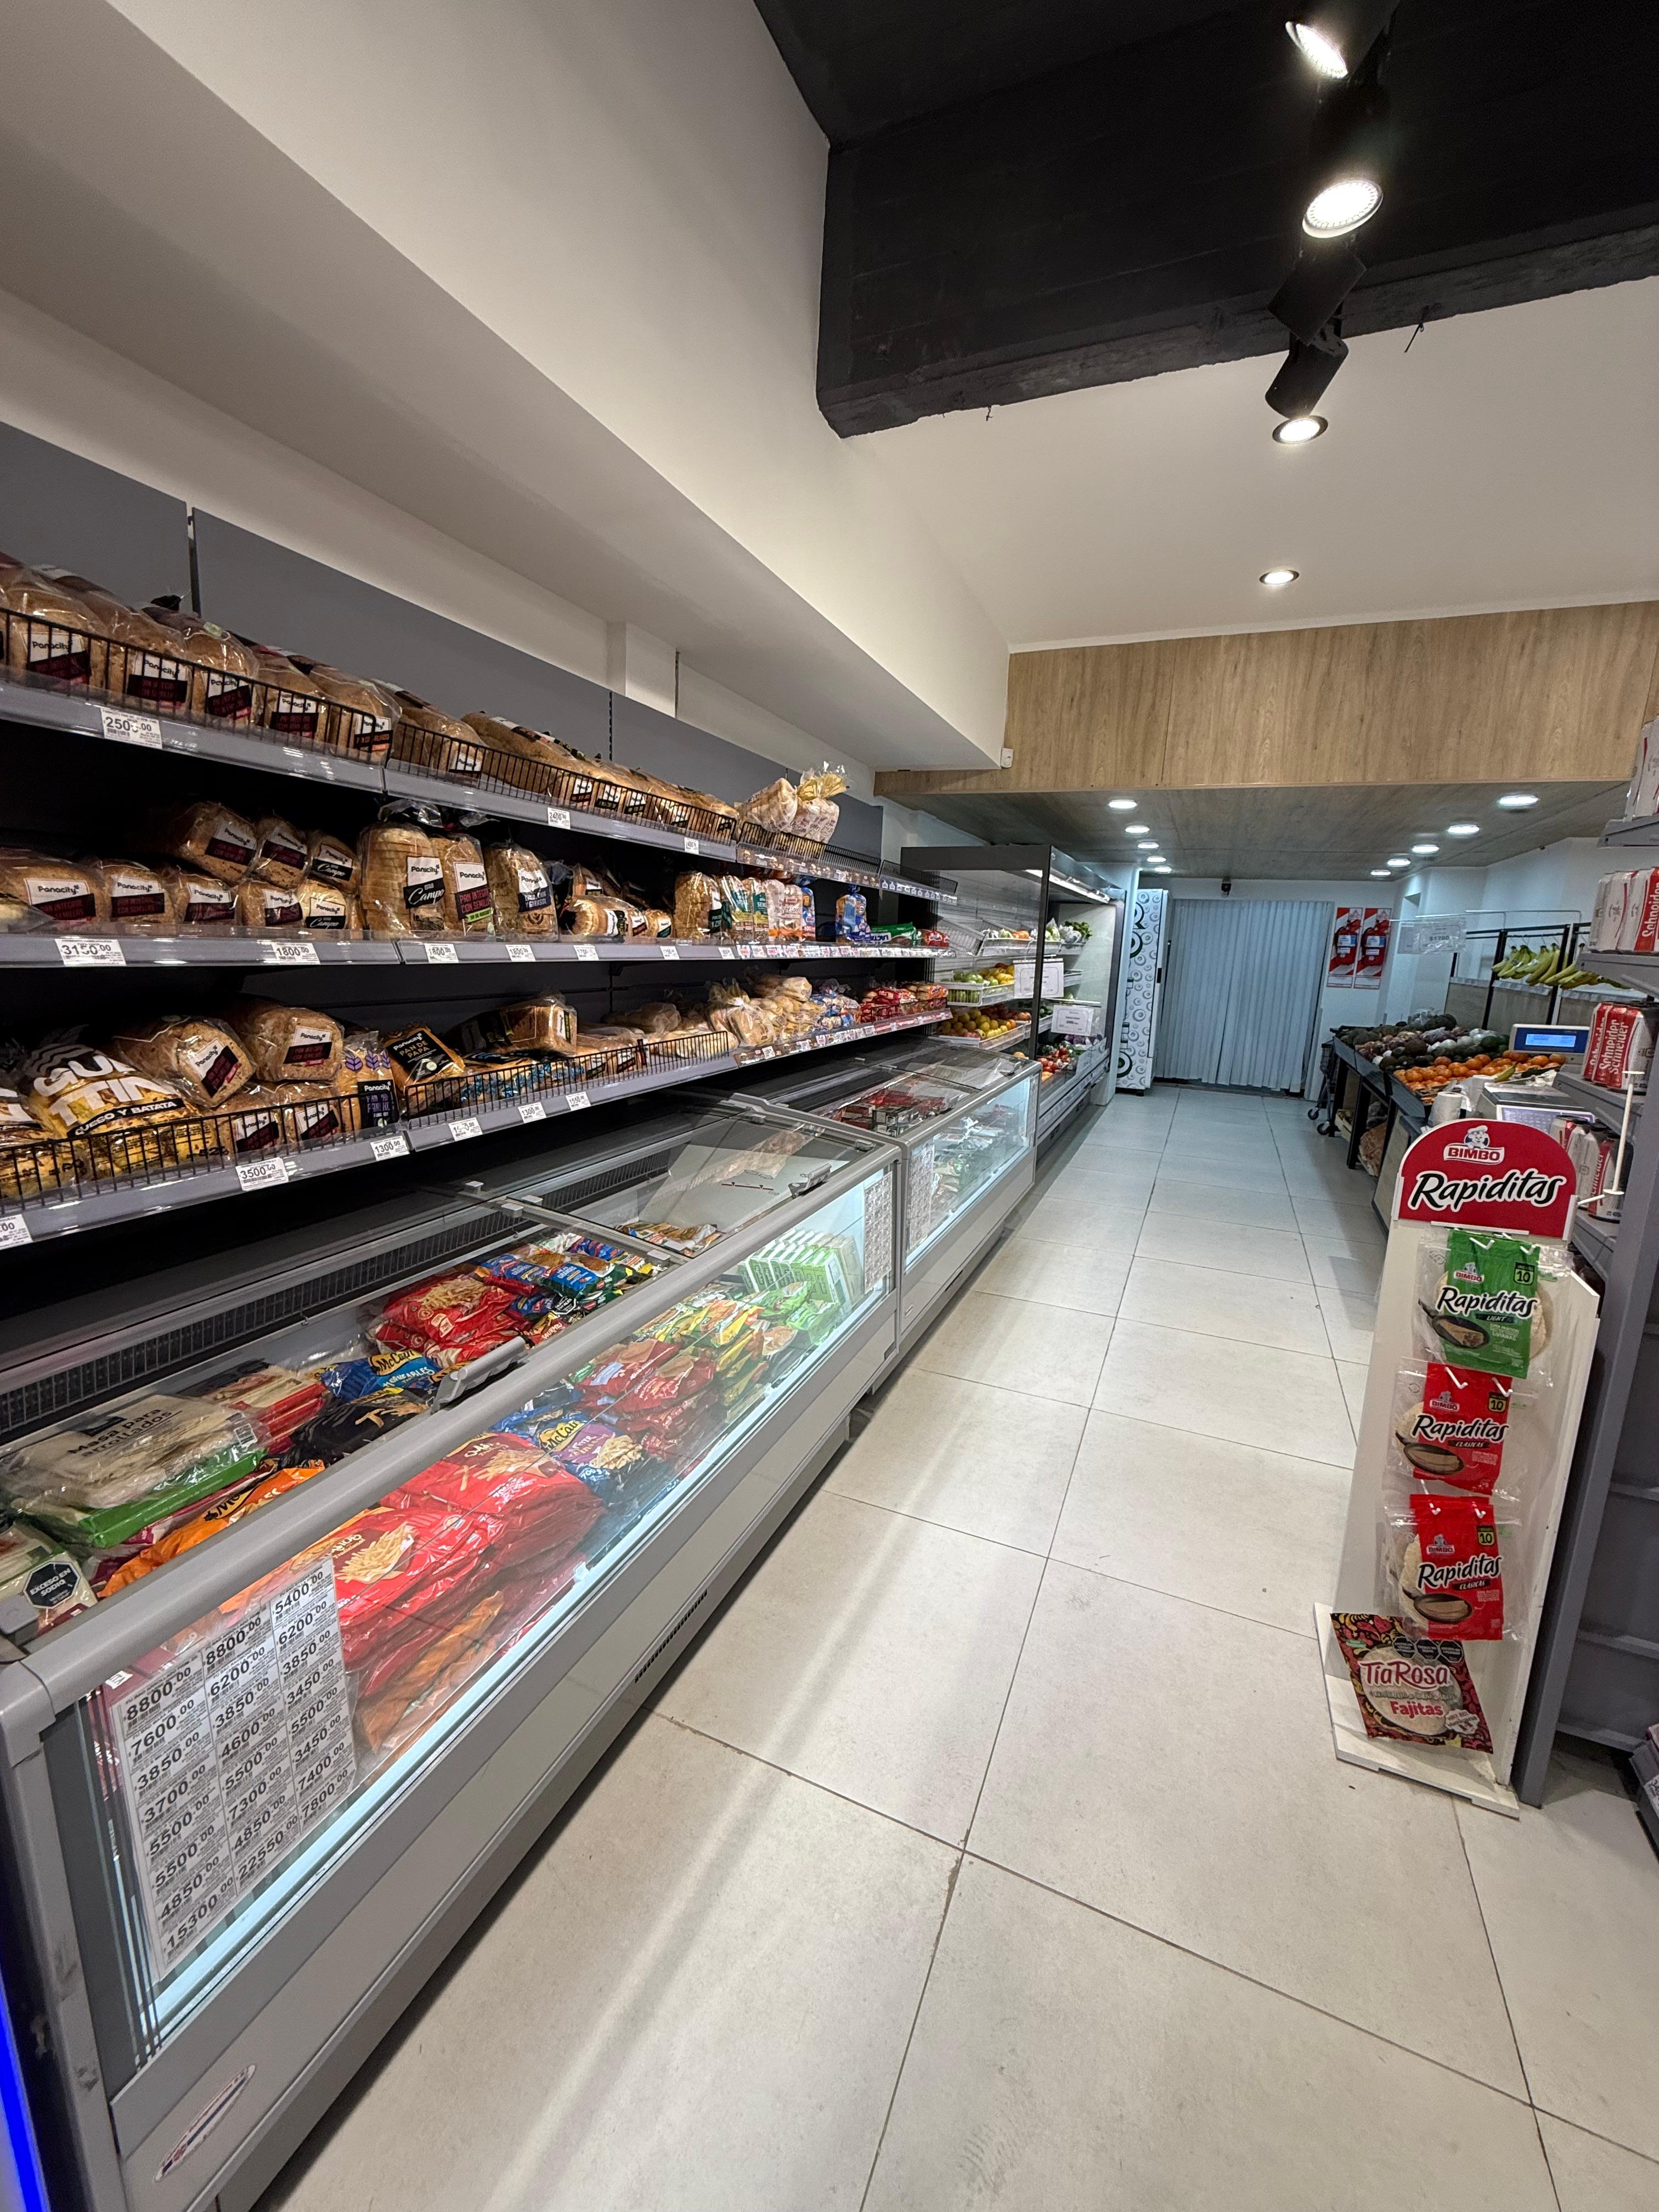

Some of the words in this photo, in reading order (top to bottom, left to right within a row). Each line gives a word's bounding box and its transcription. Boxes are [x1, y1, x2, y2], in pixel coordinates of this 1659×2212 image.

[411, 865, 438, 875] Panacity
[38, 885, 77, 895] Panacity
[117, 882, 150, 893] Panacity
[194, 889, 222, 901] Panacity
[408, 886, 444, 905] Campo
[317, 904, 339, 915] Panacity
[310, 917, 339, 929] Campo
[301, 1032, 324, 1042] Panacity
[393, 1033, 422, 1051] Panacity
[1599, 1019, 1620, 1069] Schneider
[400, 1044, 415, 1056] PAN
[415, 1040, 428, 1050] DE
[407, 1046, 429, 1058] PAPA
[1609, 1022, 1629, 1075] Schneider
[196, 1047, 218, 1067] Panacity
[364, 1083, 390, 1092] Panacity
[75, 1113, 115, 1136] QUESO
[119, 1108, 128, 1116] Y
[131, 1101, 177, 1114] BATATA
[1448, 1147, 1500, 1161] BIMBO
[1410, 1171, 1564, 1211] Rapiditas
[1455, 1272, 1482, 1282] BIMBO
[1516, 1271, 1531, 1283] 10
[1437, 1286, 1538, 1317] Rapiditas
[376, 1349, 415, 1370] McCain
[1431, 1400, 1458, 1411] BIMBO
[1490, 1400, 1504, 1410] 10
[67, 1430, 120, 1454] Masa
[122, 1409, 161, 1429] para
[81, 1412, 172, 1457] arrollados
[1412, 1415, 1509, 1441] Rapiditas
[1480, 1533, 1492, 1544] 10
[1418, 1555, 1502, 1589] Rapiditas
[30, 1576, 59, 1595] EXCESO
[59, 1568, 71, 1578] EN
[40, 1579, 66, 1597] SODIO
[1459, 1579, 1485, 1590] CLASICAS
[1390, 1661, 1449, 1690] Rosa
[1390, 1701, 1444, 1718] Fajitas
